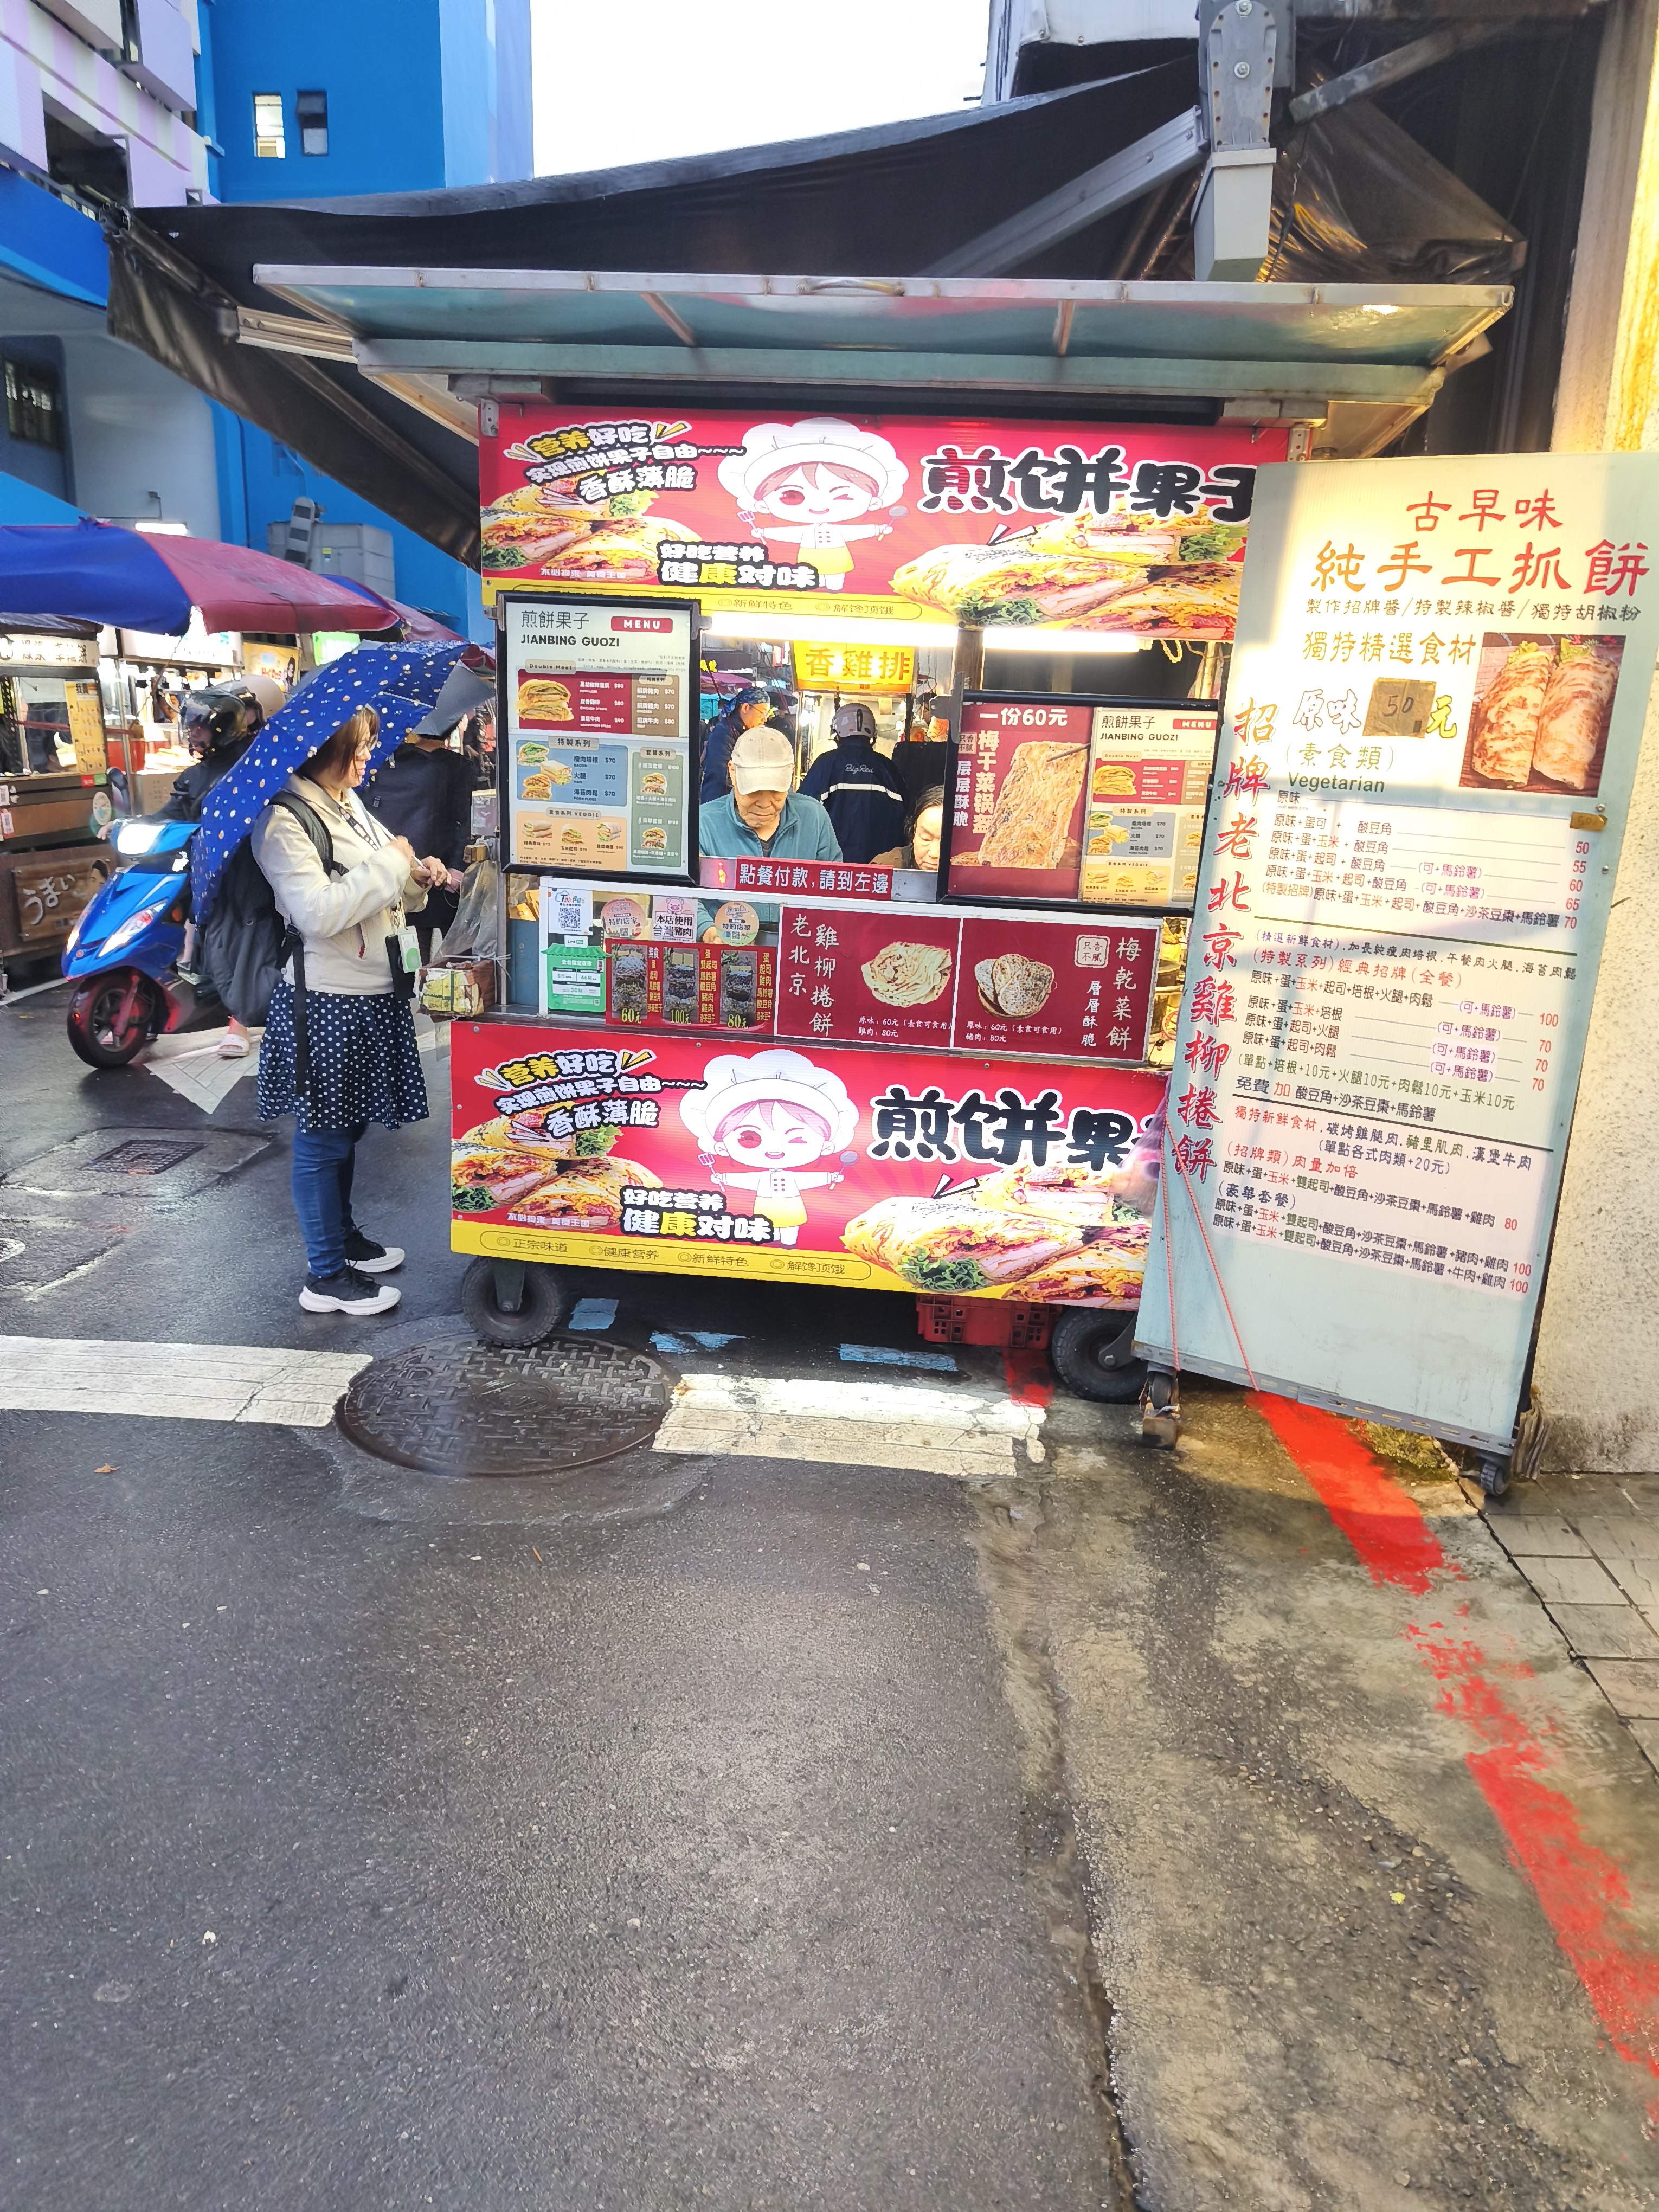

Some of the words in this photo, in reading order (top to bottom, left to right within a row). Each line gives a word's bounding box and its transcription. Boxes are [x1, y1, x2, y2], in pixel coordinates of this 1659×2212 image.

[530, 424, 650, 459] 营养好吃
[580, 466, 696, 501] 香酥薄脆
[922, 448, 1256, 522] 煎饼果子
[1406, 488, 1564, 532] 古早味
[660, 544, 765, 562] 好吃营养
[660, 562, 815, 588] 健康对味
[1311, 539, 1650, 596] 純手工抓餅
[733, 599, 793, 610] 新鲜特色
[833, 602, 895, 616] 解馋顶饿
[521, 610, 589, 629] 煎餅果子
[624, 619, 660, 629] MENU
[521, 634, 577, 646] JIANBING
[582, 636, 620, 647] GUOZI
[1303, 632, 1476, 666] 獨特精選食材
[806, 648, 910, 680] 香雞排
[979, 708, 1068, 727] 一份60元
[1293, 689, 1362, 735] 原味
[1427, 695, 1458, 739] 元
[1101, 715, 1155, 729] 煎餅果子
[557, 738, 590, 747] 特製系列
[1288, 772, 1385, 793] Vegetarian
[953, 760, 972, 826] 层层酥脆
[1277, 790, 1301, 805] 原味
[1576, 841, 1590, 855] 50
[1572, 860, 1587, 874] 55
[1569, 879, 1583, 892] 60
[23, 874, 76, 925] うまい
[1566, 898, 1580, 911] 65
[608, 917, 638, 925] 特約店家
[657, 915, 693, 926] 本店使用
[722, 923, 751, 931] 特約店家
[1564, 916, 1577, 929] 70
[653, 924, 692, 937] 台灣豬肉
[648, 947, 659, 959] 素食
[705, 949, 711, 959] 蛋
[763, 953, 769, 963] 蛋
[788, 914, 812, 997] 老北京
[700, 960, 717, 969] 雙起司
[759, 964, 771, 975] 起司
[700, 972, 716, 981] 馬鈴薯
[759, 975, 771, 986] 雞肉
[809, 923, 839, 1037] 雞柳捲餅
[700, 982, 716, 992] 酸豆角
[757, 988, 773, 998] 馬鈴薯
[1105, 936, 1142, 1052] 梅乾菜餅
[757, 1000, 773, 1009] 酸豆角
[621, 1008, 642, 1024] 60元
[670, 1009, 691, 1025] 100元
[1080, 981, 1102, 1047] 層層酥脆
[1539, 1013, 1559, 1027] 100
[728, 1014, 748, 1030] 80元
[1539, 1039, 1552, 1053] 70
[499, 1054, 617, 1085] 营养好吃
[1535, 1058, 1548, 1072] 70
[1236, 1076, 1270, 1095] 免費
[1274, 1083, 1291, 1097] 加
[1532, 1078, 1545, 1091] 70
[546, 1101, 659, 1138] 香酥薄脆
[623, 1189, 725, 1210] 好吃营养
[623, 1208, 773, 1242] 健康对味
[1504, 1217, 1517, 1231] 80
[513, 1238, 569, 1253] 正宗味道
[603, 1246, 660, 1260] 健康营养
[692, 1252, 749, 1268] 新鲜特色
[787, 1259, 846, 1276] 解馋顶饿
[1513, 1262, 1532, 1277] 100
[1509, 1279, 1529, 1294] 100
